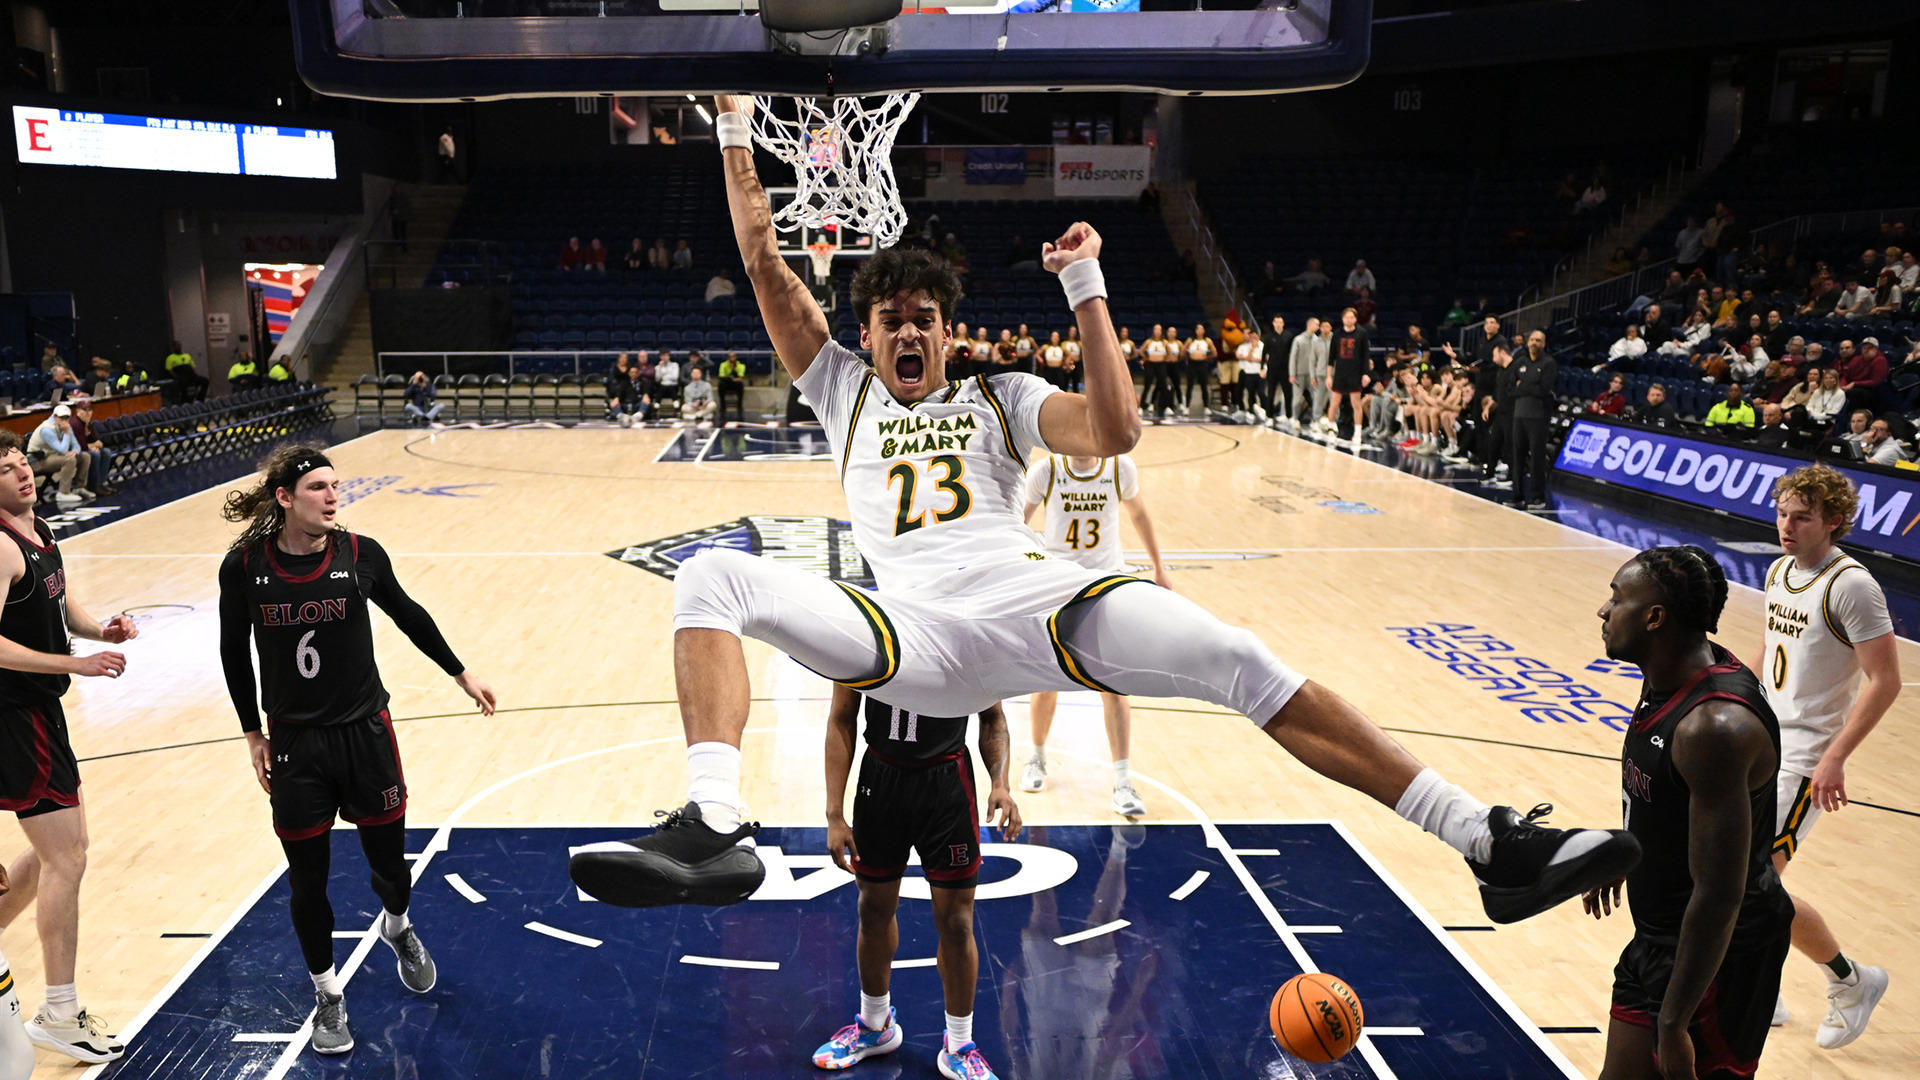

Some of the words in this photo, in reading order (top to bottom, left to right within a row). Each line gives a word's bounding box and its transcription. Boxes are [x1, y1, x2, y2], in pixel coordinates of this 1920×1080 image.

[575, 97, 598, 114] 101
[981, 94, 1009, 113] 102
[1394, 91, 1421, 110] 103
[25, 118, 52, 151] E
[968, 162, 993, 170] Credit
[1069, 169, 1144, 181] FLOSPORTS
[877, 411, 979, 437] WILLIAM
[887, 454, 974, 538] 23
[1060, 492, 1108, 502] WILLIAM
[1603, 435, 1912, 536] SOLDOUT.M
[1064, 518, 1101, 551] 43
[330, 571, 349, 579] CAA
[260, 598, 347, 627] ELON
[1768, 601, 1809, 626] WILLIAM
[1427, 621, 1516, 652] AIR
[296, 630, 321, 680] 6
[1773, 643, 1788, 692] 0
[1385, 626, 1588, 723] RESERVE
[381, 785, 400, 811] E
[949, 844, 969, 867] E
[1315, 1000, 1345, 1042] NCAA
